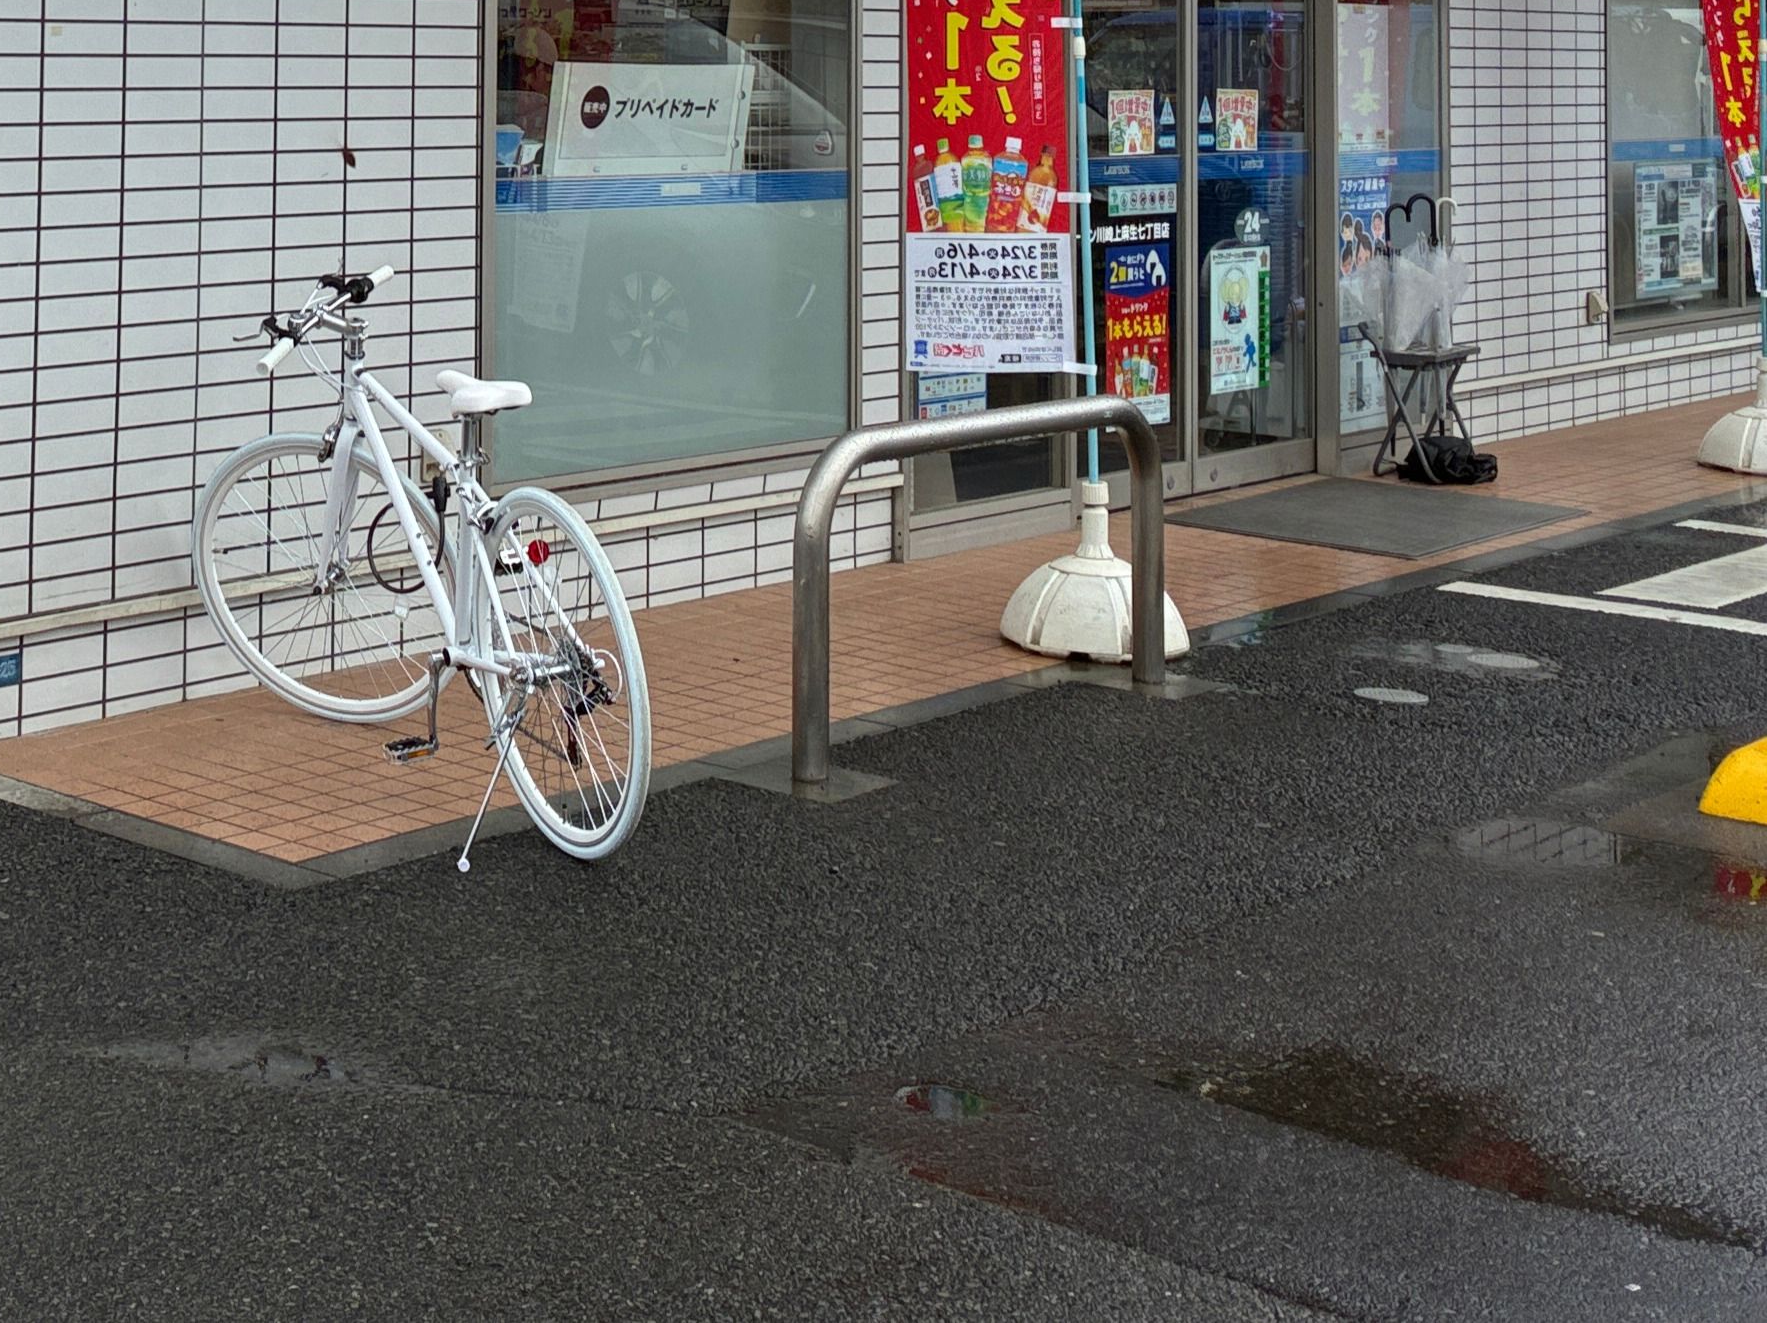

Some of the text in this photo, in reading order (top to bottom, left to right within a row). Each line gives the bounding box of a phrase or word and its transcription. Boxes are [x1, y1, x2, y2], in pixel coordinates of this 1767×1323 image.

[614, 97, 720, 119] プリペイドカード
[1244, 210, 1261, 233] 24
[1106, 313, 1167, 342] 1本もらえる!
